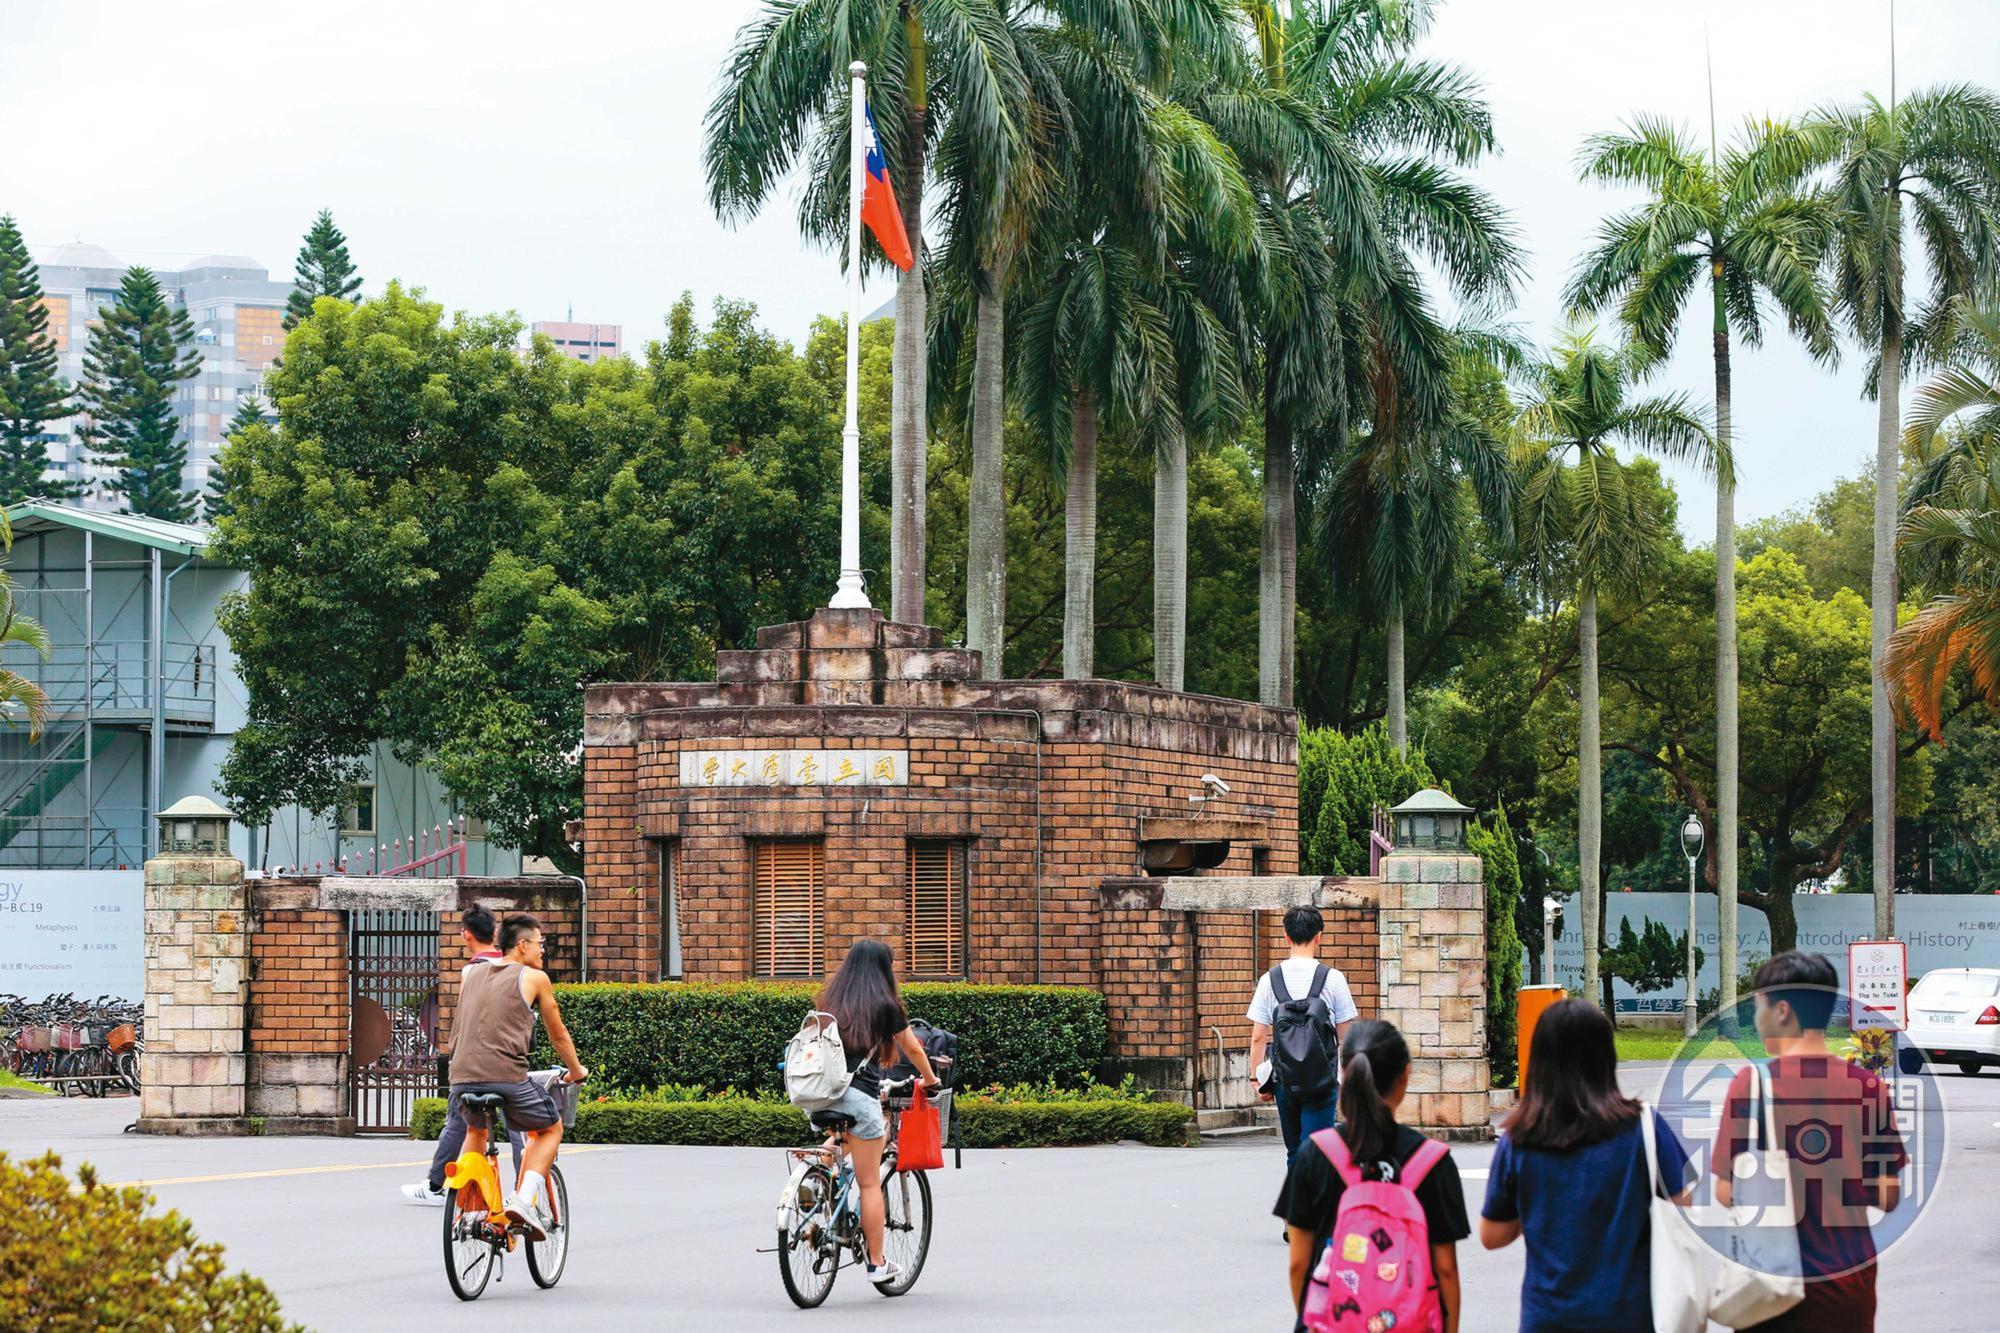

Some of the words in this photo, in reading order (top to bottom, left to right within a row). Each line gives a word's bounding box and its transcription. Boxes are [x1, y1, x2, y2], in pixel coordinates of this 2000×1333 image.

[35, 924, 78, 932] Metaphysics
[1908, 930, 1975, 952] History
[24, 962, 72, 970] Functionalism
